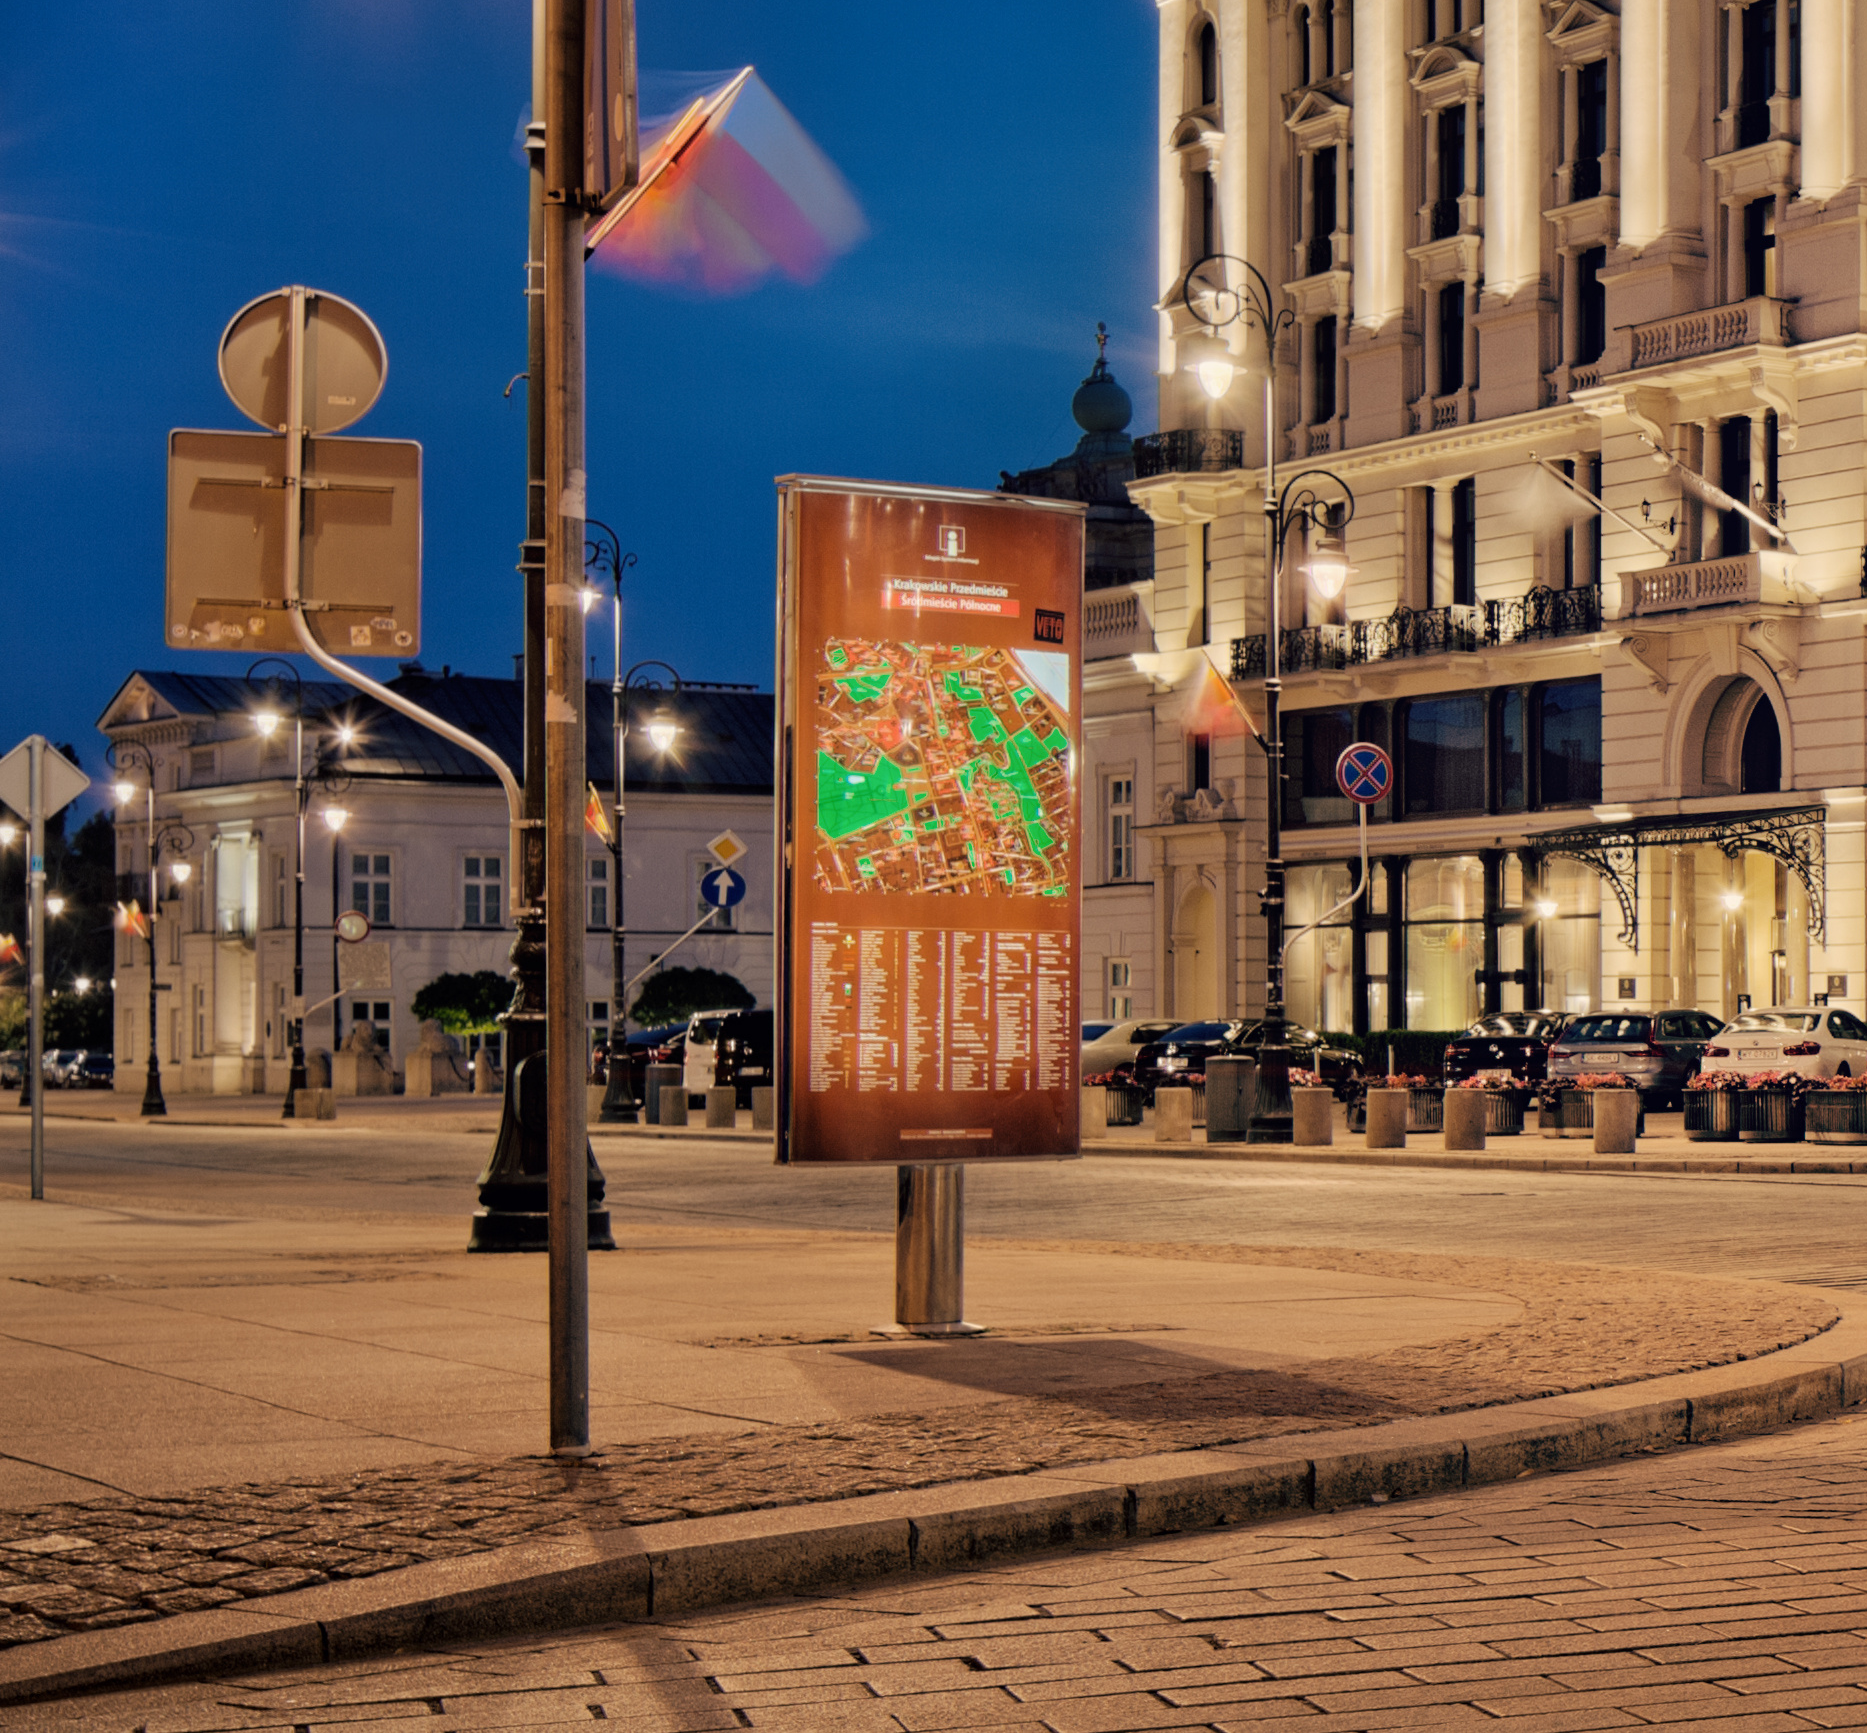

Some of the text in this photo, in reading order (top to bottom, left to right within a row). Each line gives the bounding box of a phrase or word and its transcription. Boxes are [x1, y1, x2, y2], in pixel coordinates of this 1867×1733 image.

[893, 578, 1009, 598] Krakowskie Przedmieście
[900, 593, 1002, 613] Śródmieście Północne
